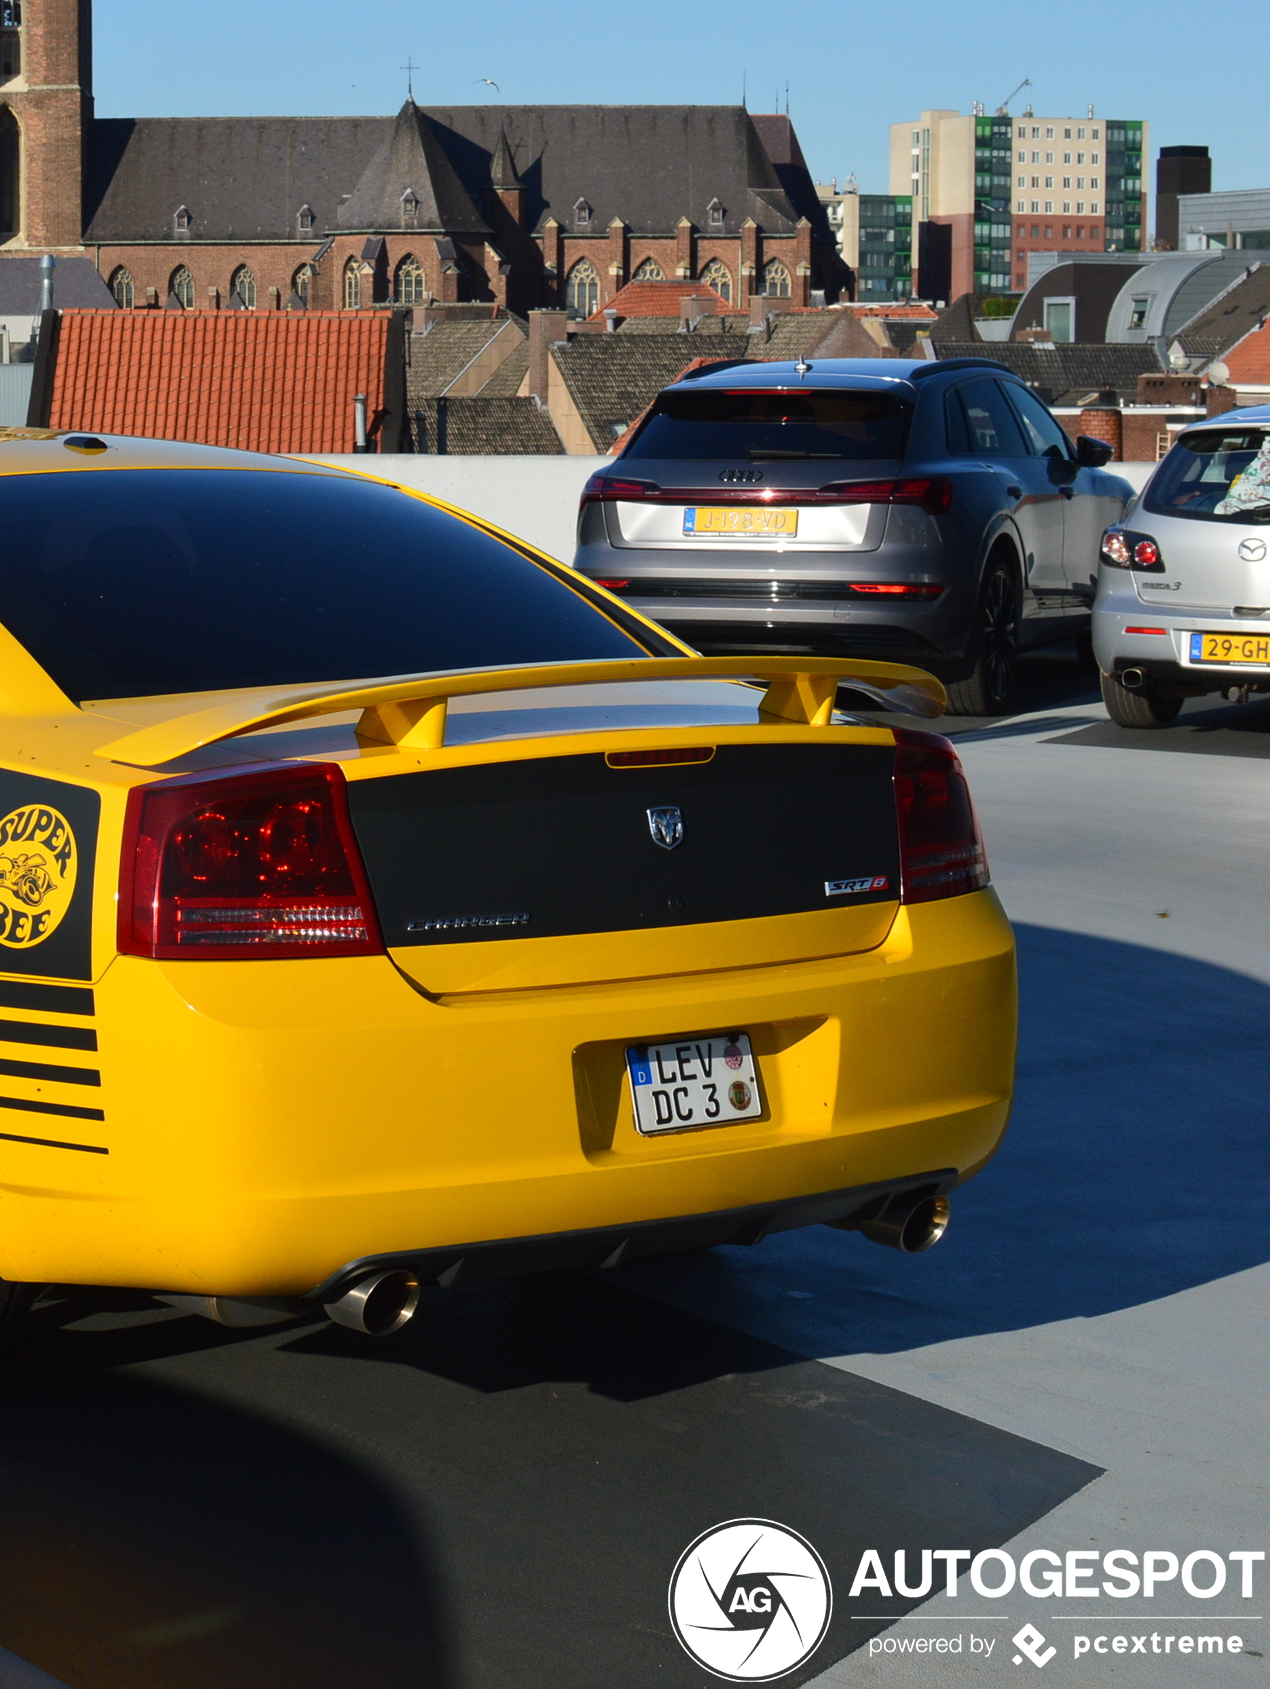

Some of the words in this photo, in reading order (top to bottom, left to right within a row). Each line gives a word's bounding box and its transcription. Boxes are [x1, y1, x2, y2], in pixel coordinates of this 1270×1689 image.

[703, 511, 787, 529] J-198-VD
[1208, 638, 1268, 659] 29-GH
[407, 913, 531, 931] CHARGER
[655, 1043, 712, 1084] LEV
[637, 1071, 647, 1083] D
[651, 1086, 693, 1125] DC
[701, 1083, 721, 1118] 3
